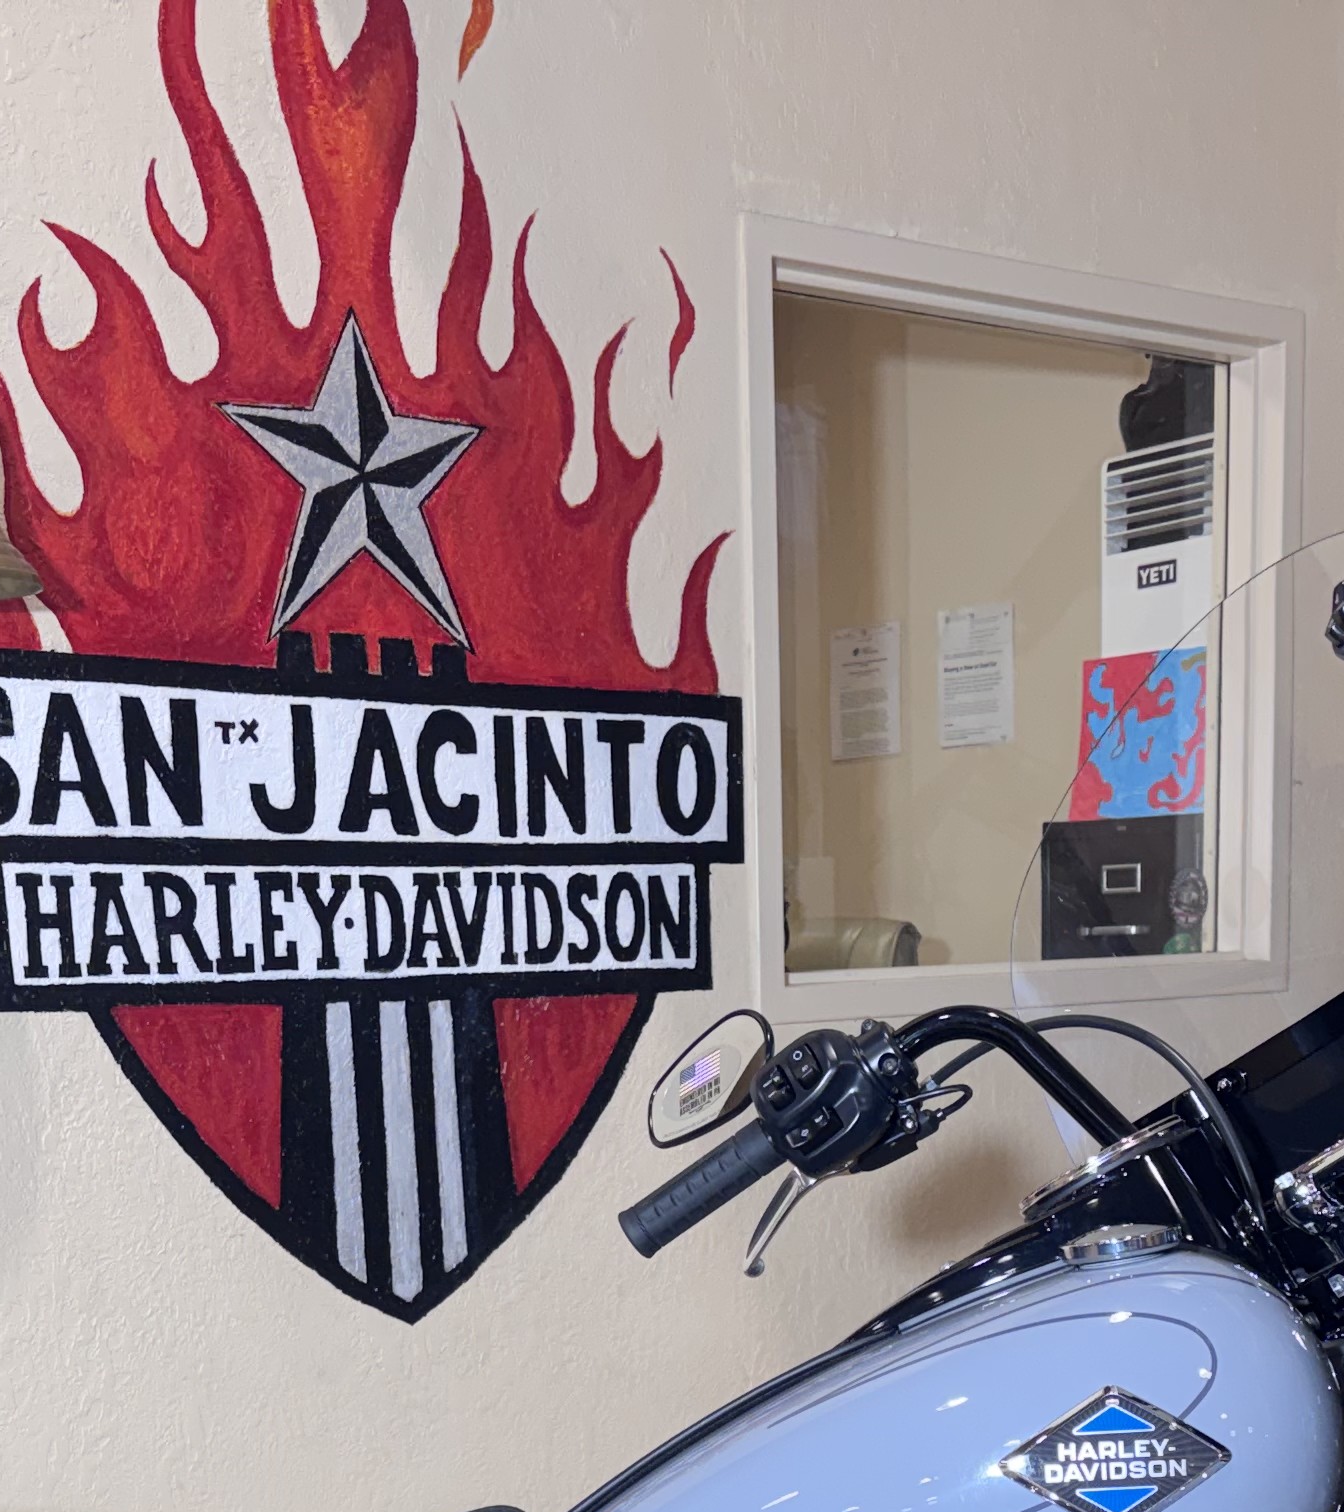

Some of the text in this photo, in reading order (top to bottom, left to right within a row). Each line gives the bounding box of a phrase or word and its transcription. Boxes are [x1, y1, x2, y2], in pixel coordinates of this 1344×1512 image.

[1139, 563, 1175, 586] YETI
[213, 718, 259, 746] TX
[249, 703, 716, 838] JACINTO
[1057, 1438, 1177, 1463] HARLEY-
[1044, 1459, 1188, 1484] DAVIDSON
